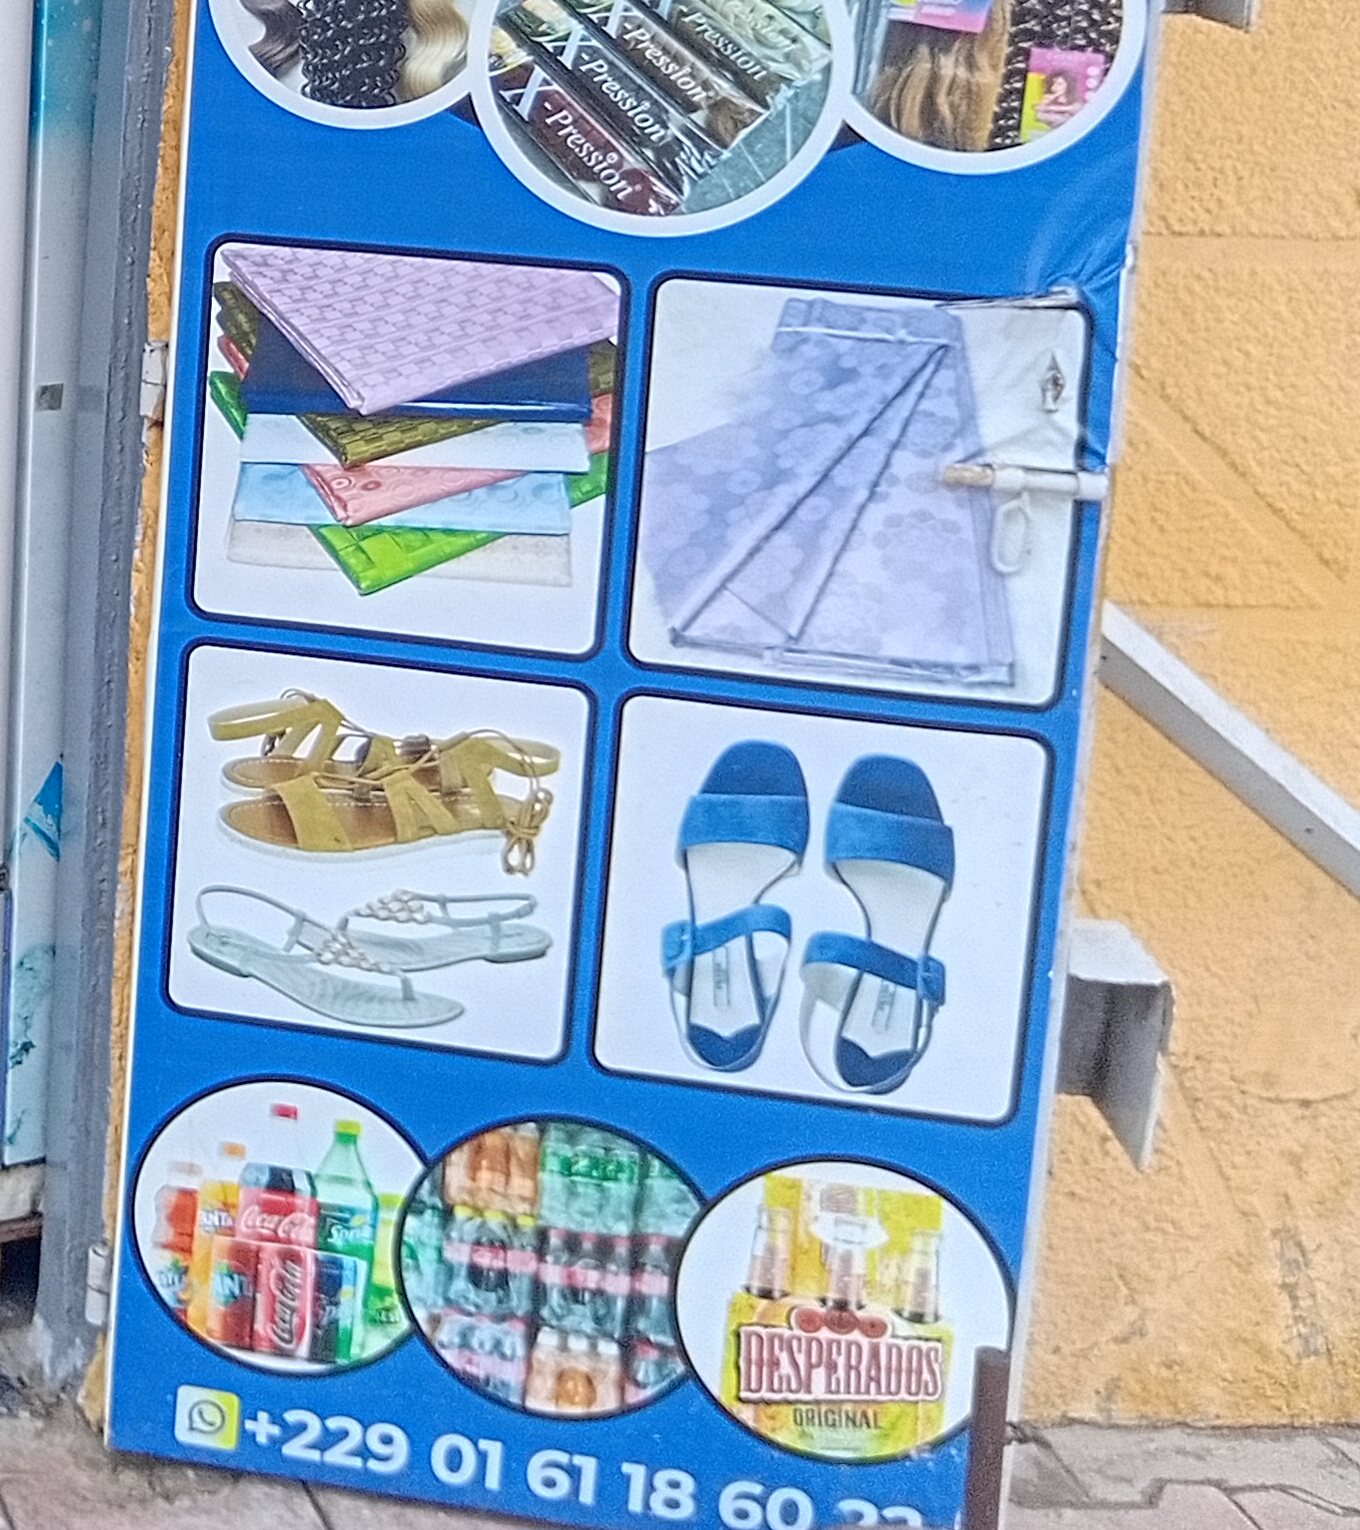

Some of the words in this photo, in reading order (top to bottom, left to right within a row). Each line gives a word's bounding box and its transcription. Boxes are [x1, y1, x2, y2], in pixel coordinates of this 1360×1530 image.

[741, 1327, 943, 1400] DESPERADOS
[792, 1407, 882, 1430] ORIGINAL
[243, 1407, 408, 1473] +229
[430, 1432, 504, 1492] 01
[526, 1446, 597, 1504] 61
[621, 1460, 696, 1520] 18
[718, 1479, 815, 1530] 60
